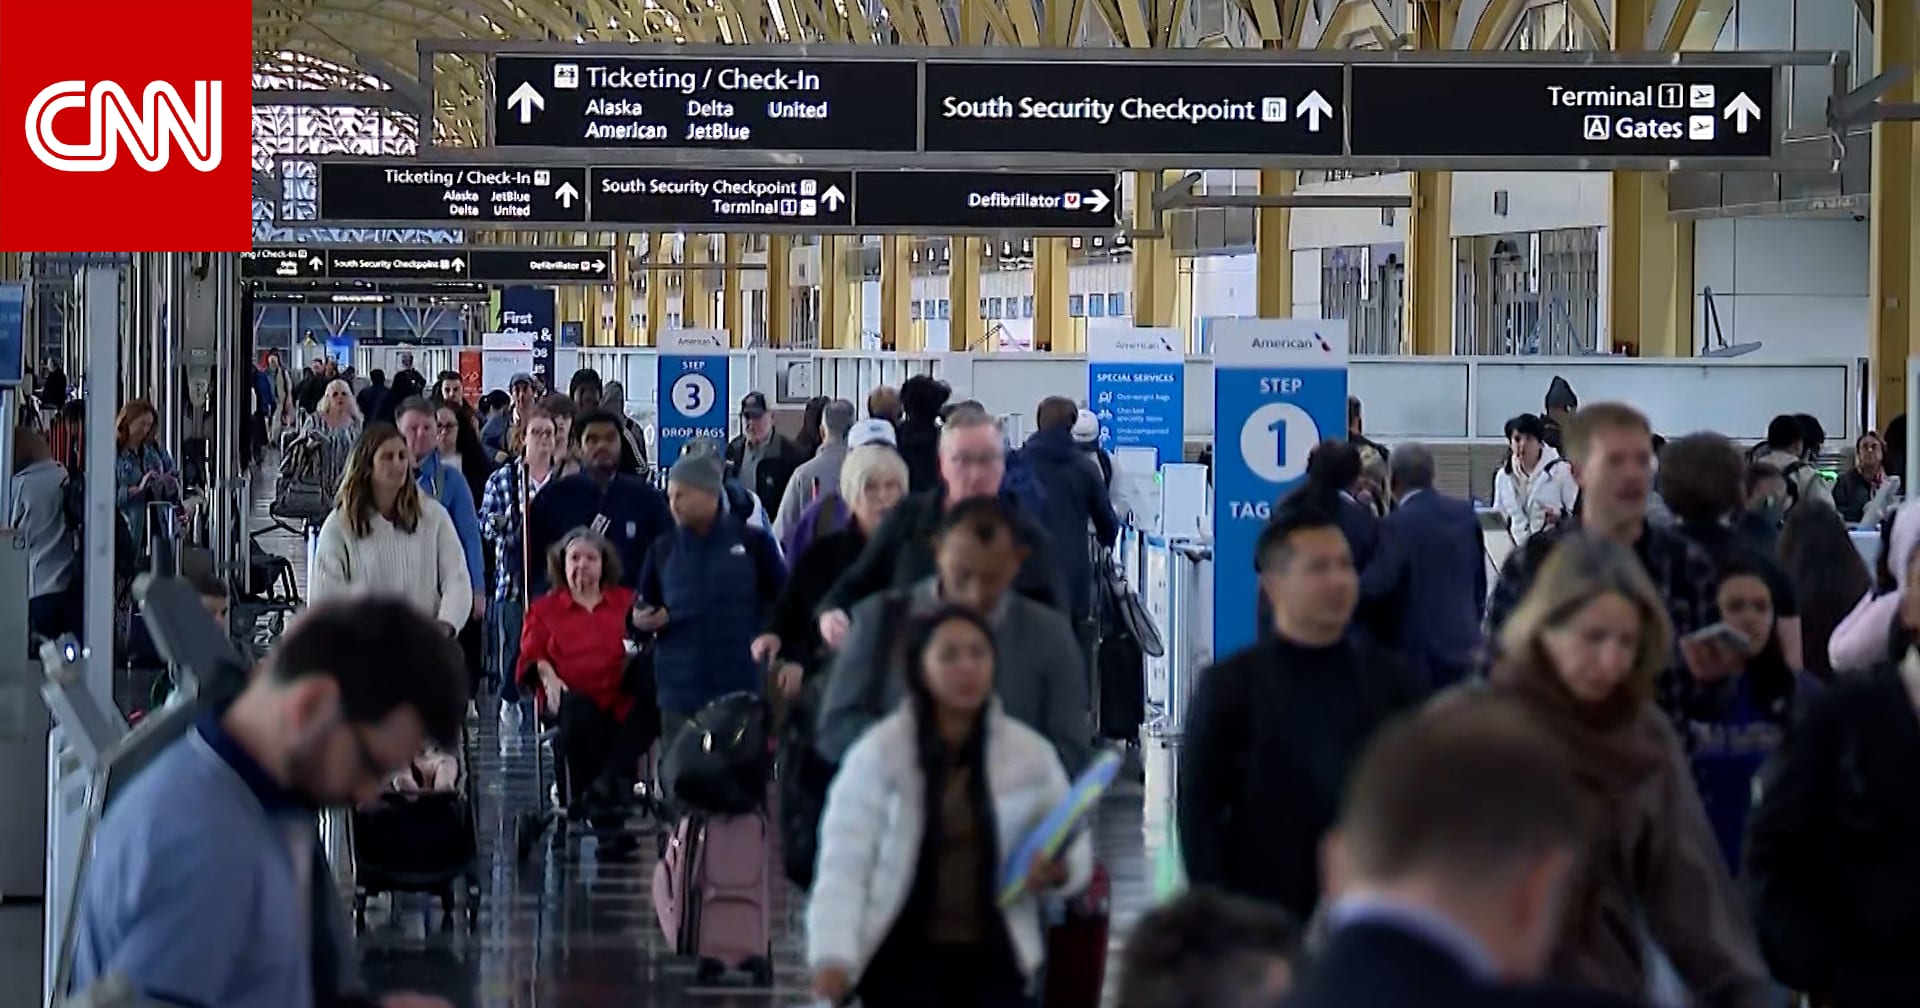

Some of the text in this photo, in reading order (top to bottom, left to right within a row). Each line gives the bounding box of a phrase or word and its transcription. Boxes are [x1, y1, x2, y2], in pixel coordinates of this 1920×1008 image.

[586, 67, 819, 94] Ticketing / Check-In
[1547, 86, 1652, 106] Terminal
[586, 99, 827, 118] Alaska Delta United
[943, 96, 1255, 123] South Security Checkpoint
[584, 122, 750, 140] American JetBlue
[1616, 117, 1683, 138] Gates
[384, 170, 530, 187] Ticketing / Check-In
[443, 190, 530, 201] Alaska JetBlue
[602, 179, 797, 197] South Security Checkpoint
[712, 199, 778, 214] Terminal
[968, 192, 1061, 207] Defibrillator
[450, 204, 530, 216] Delta United
[360, 260, 391, 269] Security
[393, 260, 439, 269] Checkpoint
[504, 311, 532, 324] First
[541, 328, 552, 341] &
[1252, 338, 1312, 348] American
[681, 361, 706, 370] STEP
[1097, 374, 1174, 382] SPECIAL SERVICES
[1261, 378, 1301, 393] STEP
[686, 384, 700, 409] 3
[662, 427, 725, 438] DROP BAGS
[1268, 420, 1286, 466] 1
[1230, 502, 1270, 519] TAG
